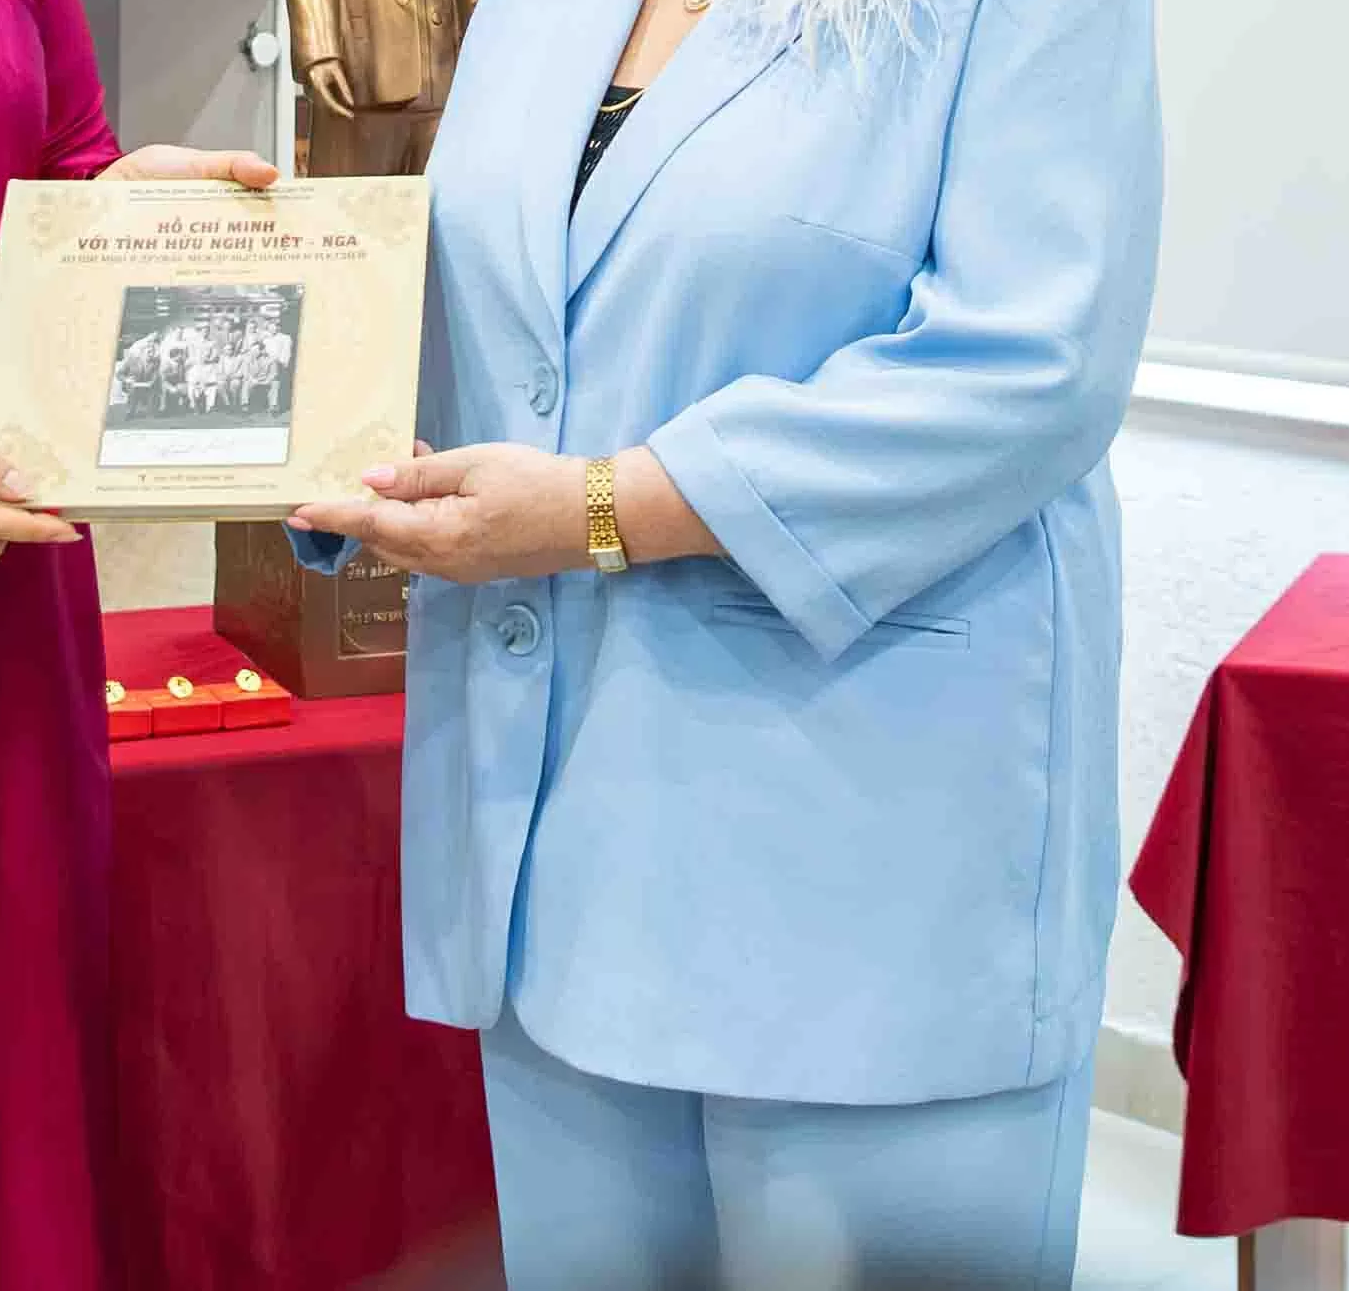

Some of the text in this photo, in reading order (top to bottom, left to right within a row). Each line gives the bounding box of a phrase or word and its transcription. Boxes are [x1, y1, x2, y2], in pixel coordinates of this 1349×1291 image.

[157, 216, 276, 234] HỒ CHÍ MINH
[78, 234, 109, 250] VỚI
[115, 234, 158, 250] TÌNH
[210, 236, 253, 251] NGHỊ
[261, 234, 303, 250] VIỆT
[322, 234, 357, 247] NGA
